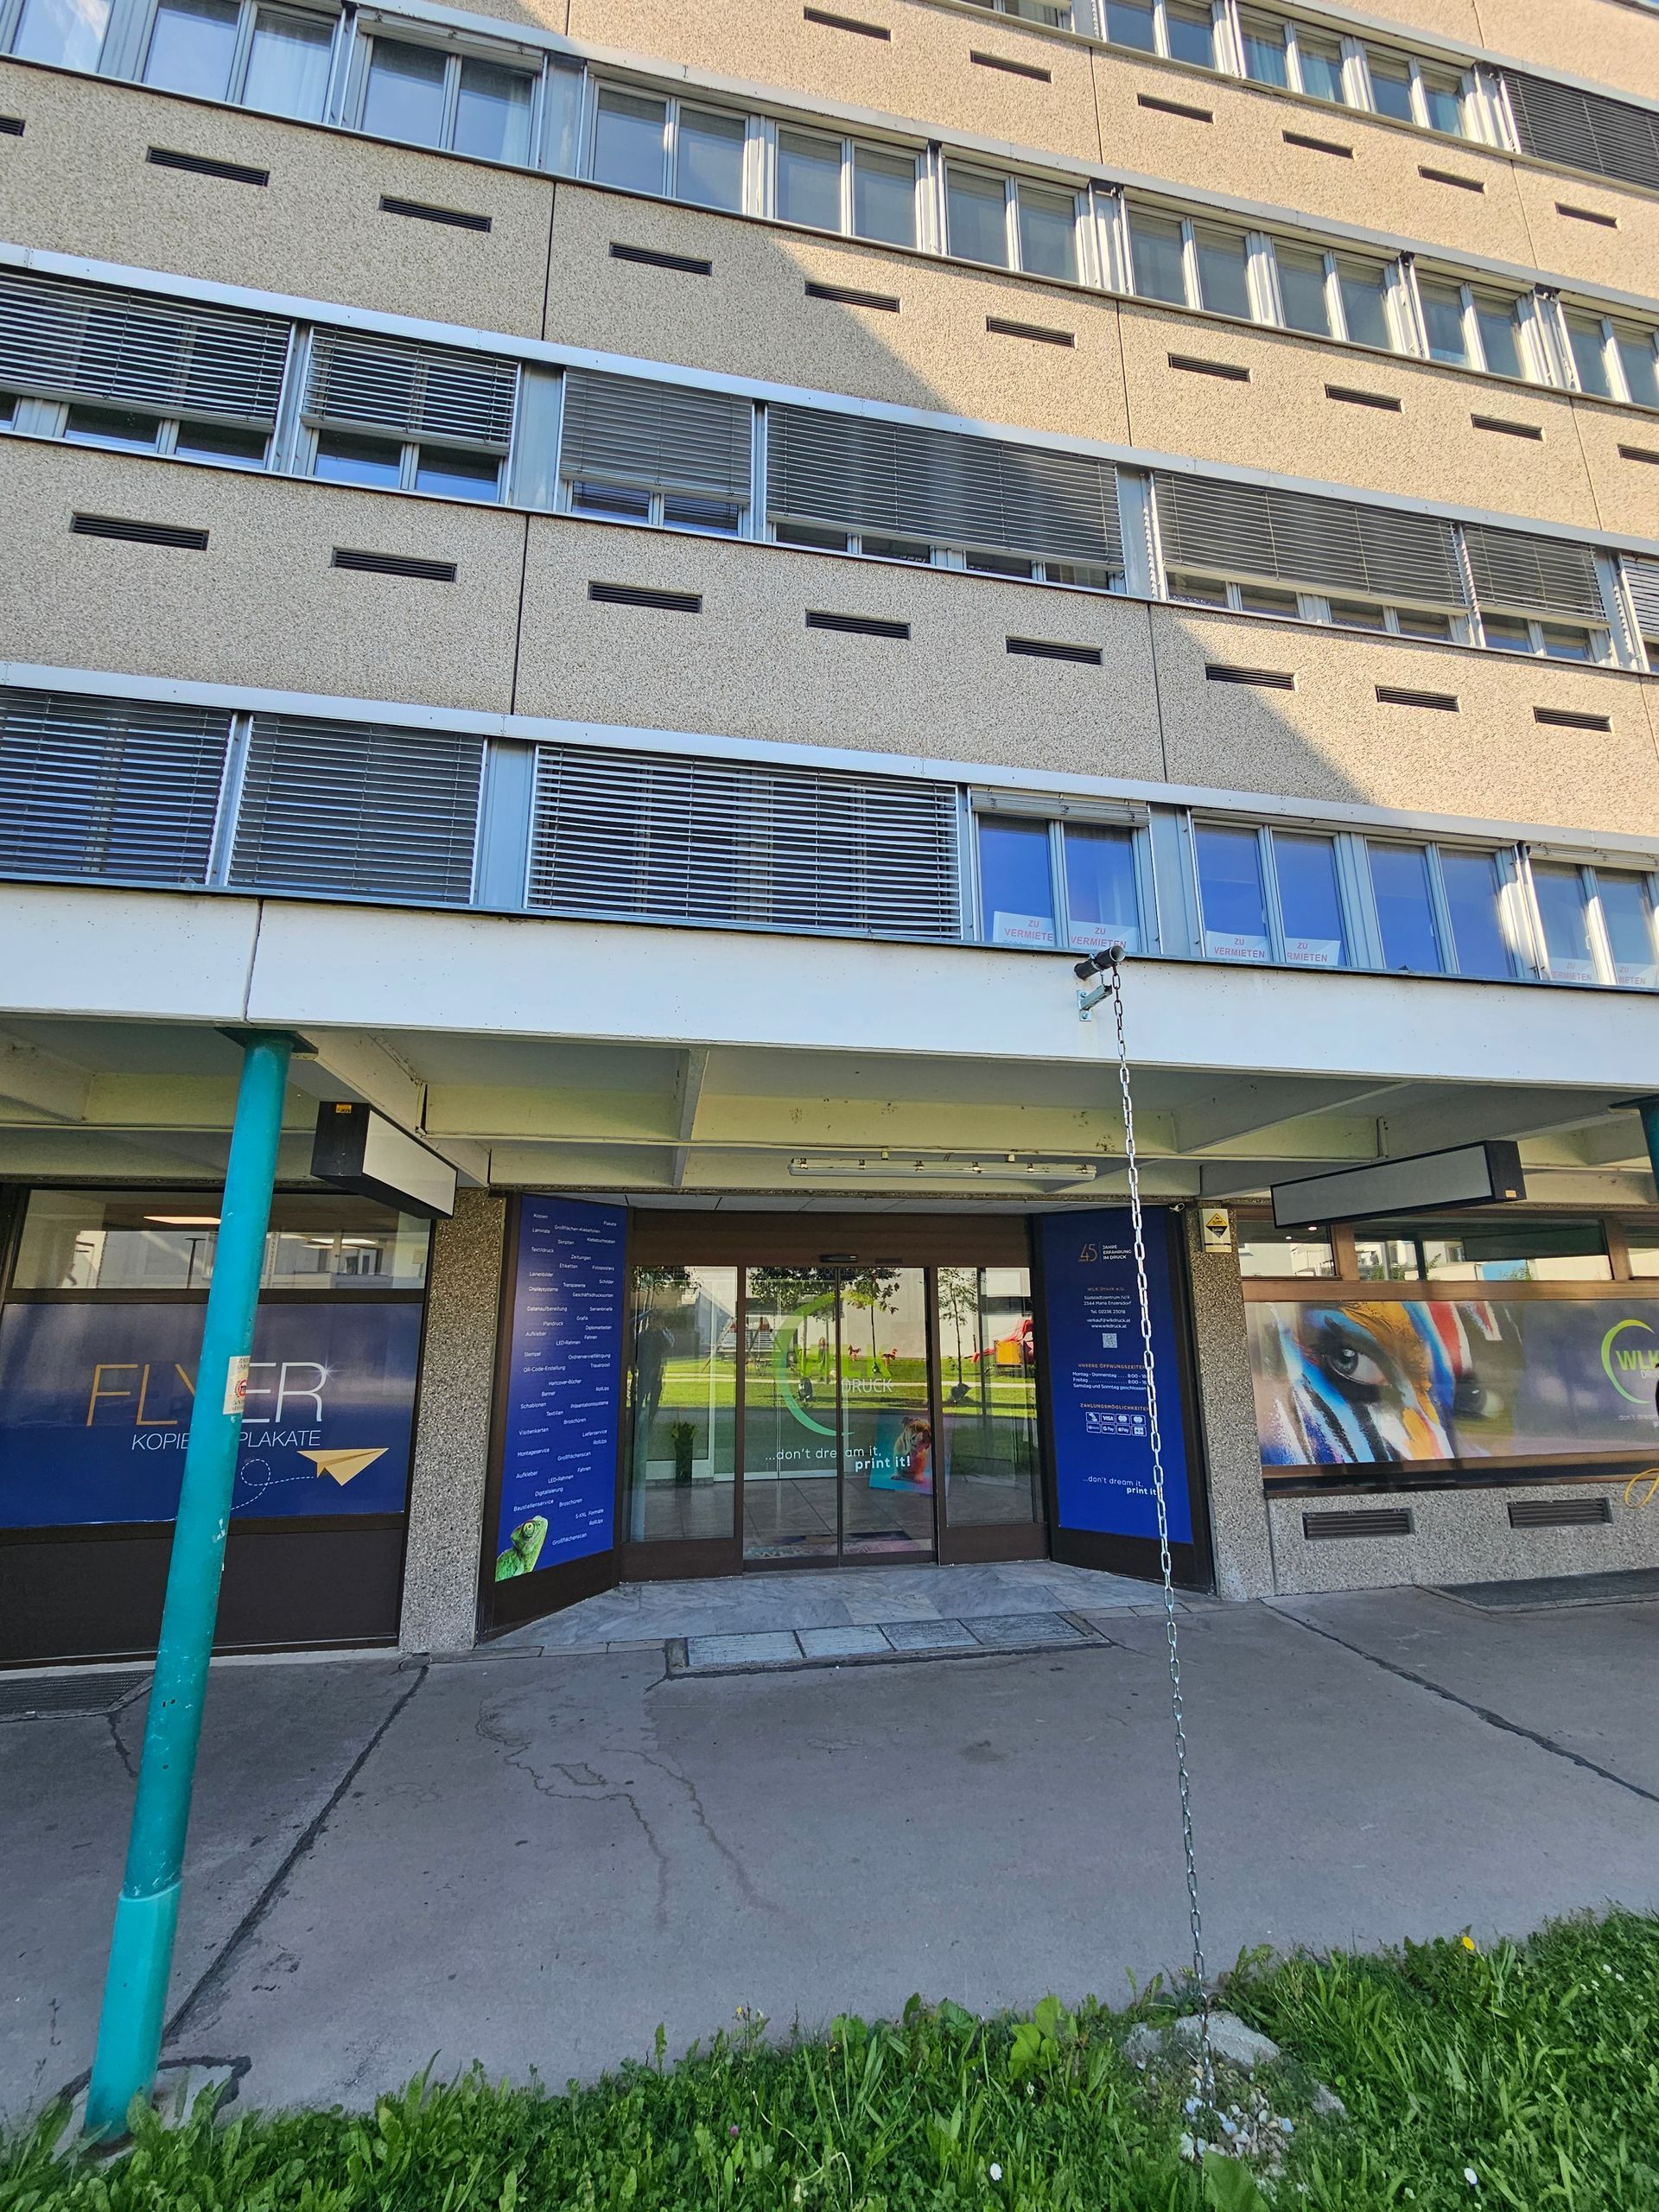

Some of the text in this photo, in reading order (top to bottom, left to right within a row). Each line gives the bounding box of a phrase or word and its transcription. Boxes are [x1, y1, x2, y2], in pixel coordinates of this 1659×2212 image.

[1004, 928, 1053, 941] VERMIETE
[1214, 947, 1265, 957] VERMIETEN
[1287, 952, 1327, 962] RMIETEN
[1078, 1244, 1097, 1262] 45
[842, 1378, 893, 1393] DRUCK
[131, 1430, 321, 1450] KOPIE PLAKATE
[855, 1456, 911, 1471] print it!
[1109, 1478, 1133, 1486] dream
